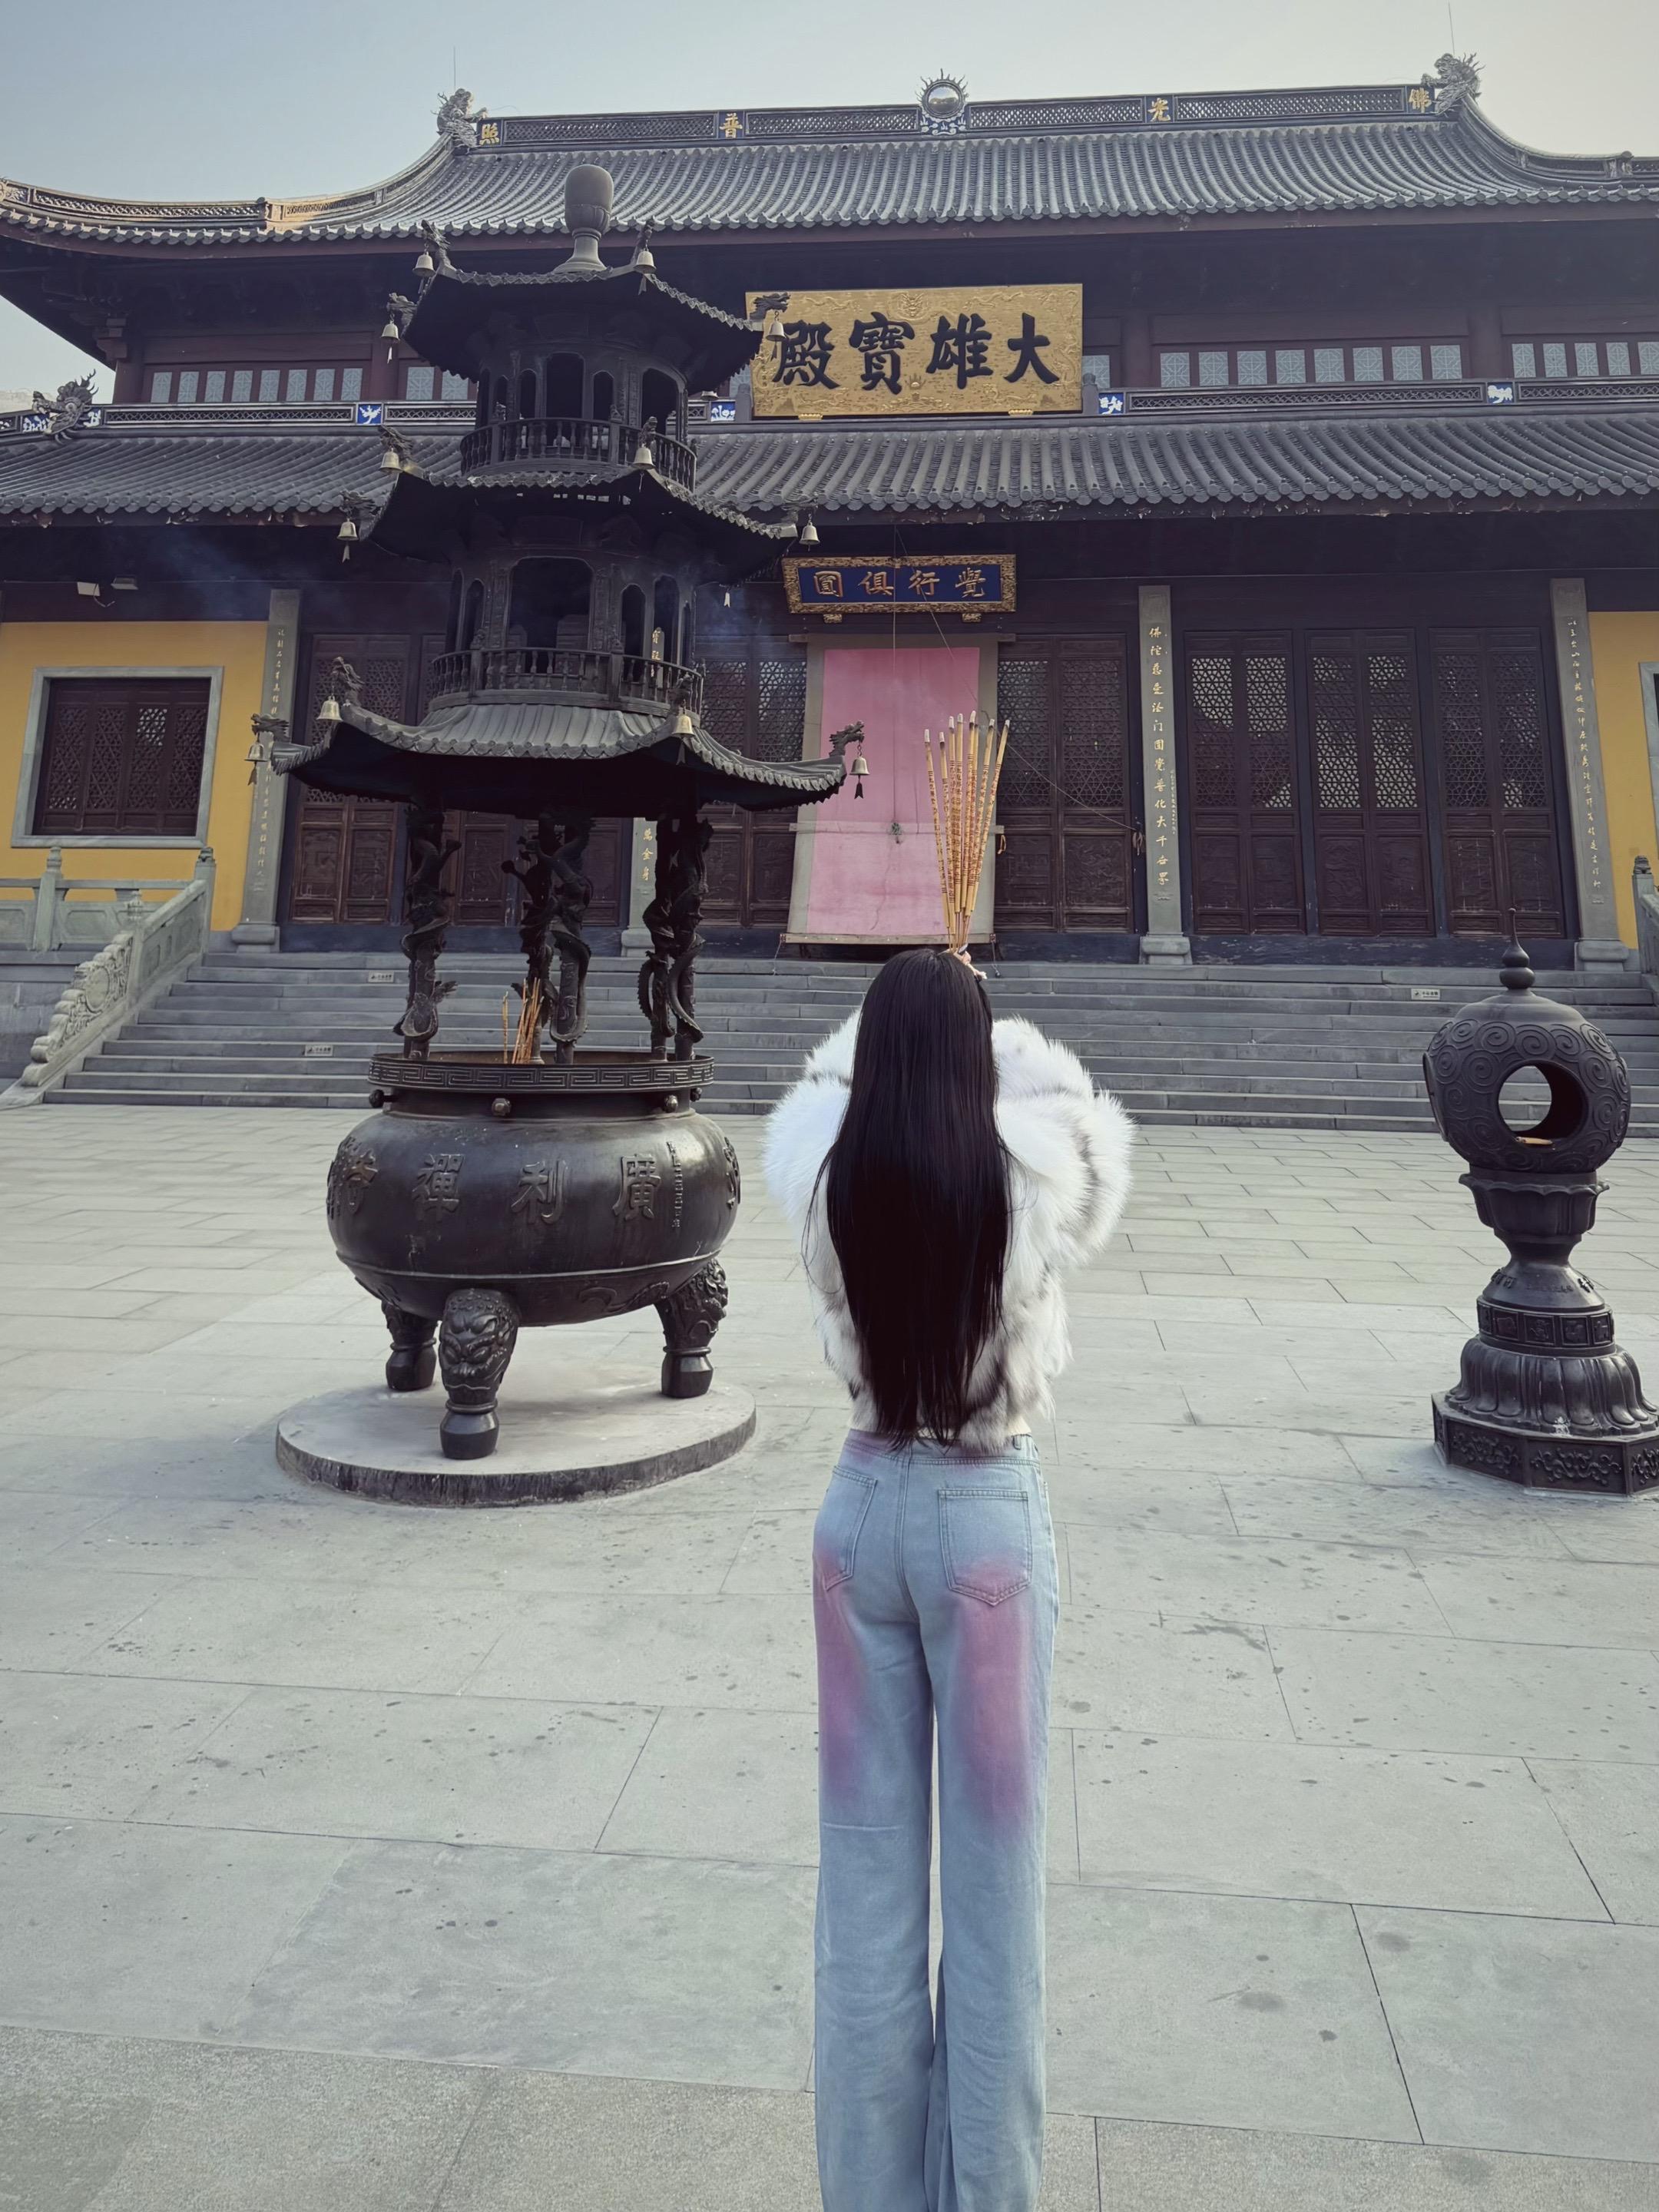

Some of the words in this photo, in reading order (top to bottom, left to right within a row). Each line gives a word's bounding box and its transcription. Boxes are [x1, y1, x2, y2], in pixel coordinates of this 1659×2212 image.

[1147, 98, 1171, 121] 光
[478, 123, 499, 146] 照
[719, 113, 743, 138] 普
[772, 312, 1061, 395] 大雄寶殿
[813, 568, 987, 598] 覺行俱圓
